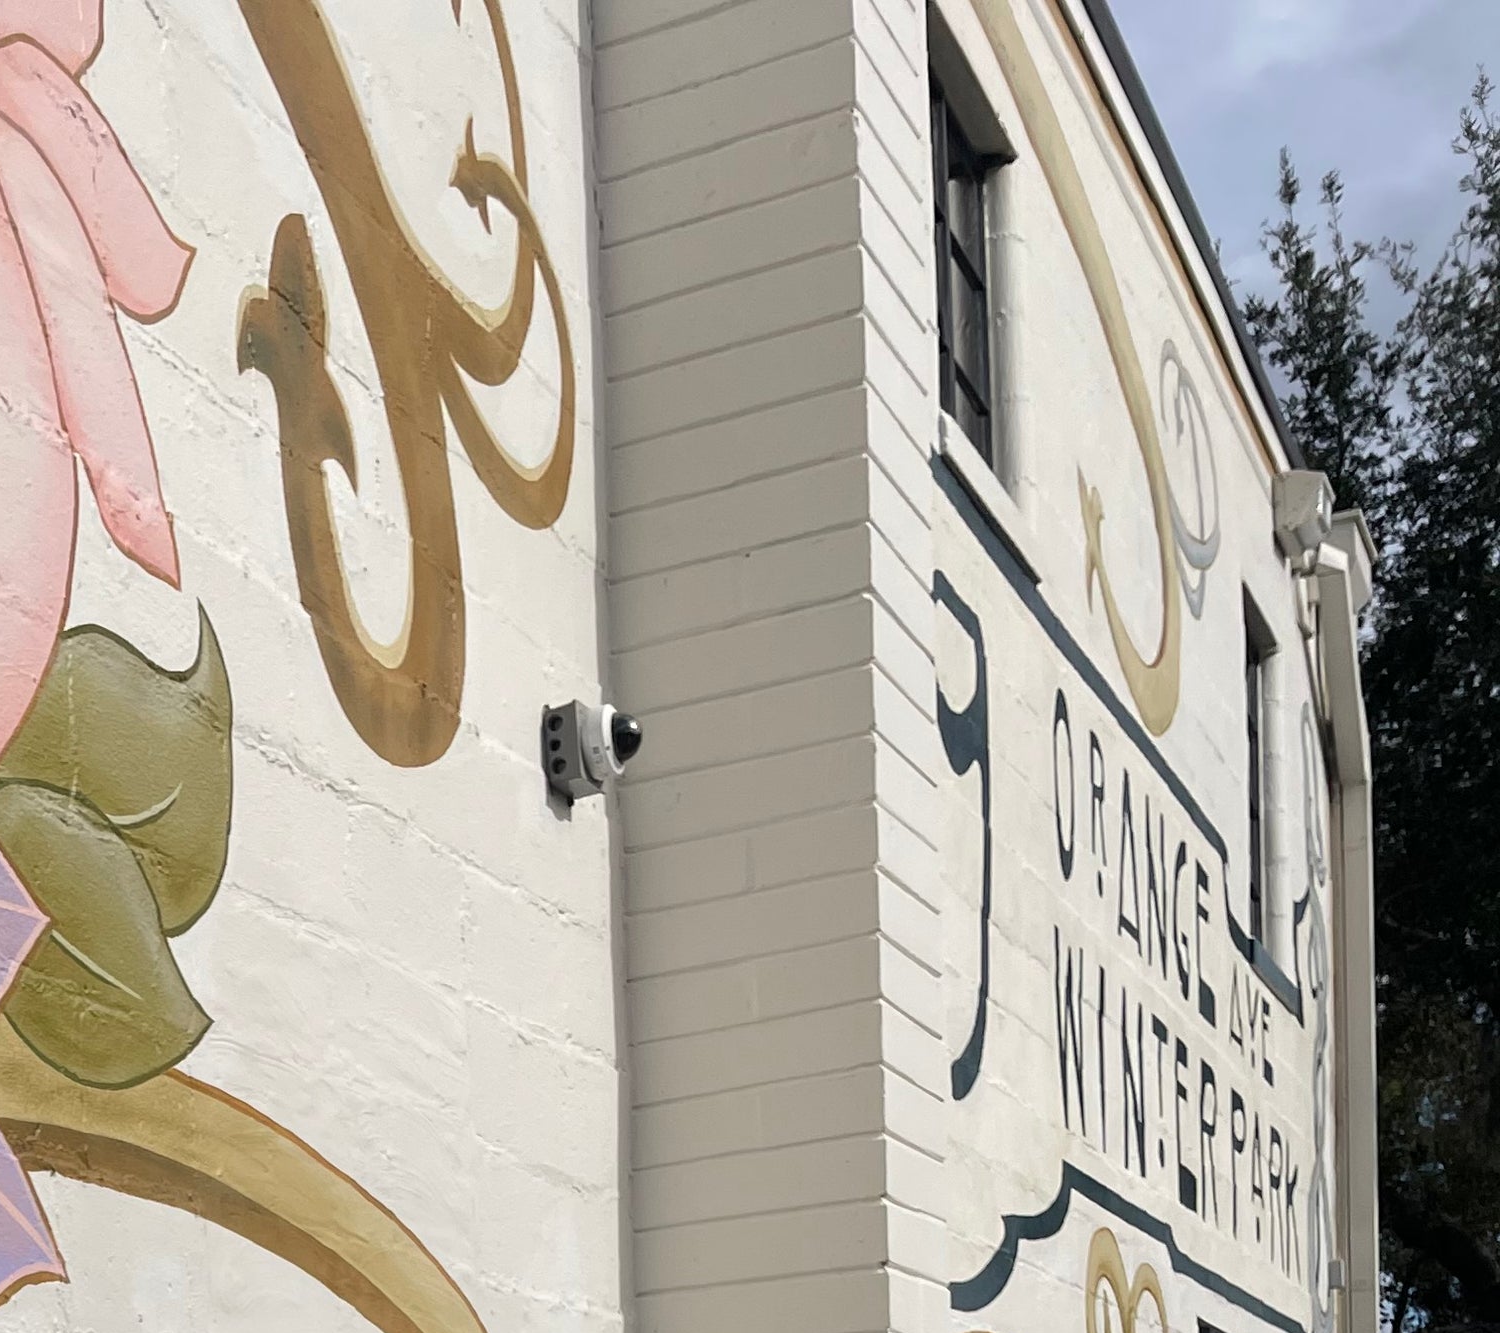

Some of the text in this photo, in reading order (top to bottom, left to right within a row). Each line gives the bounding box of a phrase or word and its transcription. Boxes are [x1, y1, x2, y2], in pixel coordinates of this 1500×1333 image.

[1053, 687, 1216, 1029] ORANGE
[1053, 925, 1300, 1285] WINTER PARK
